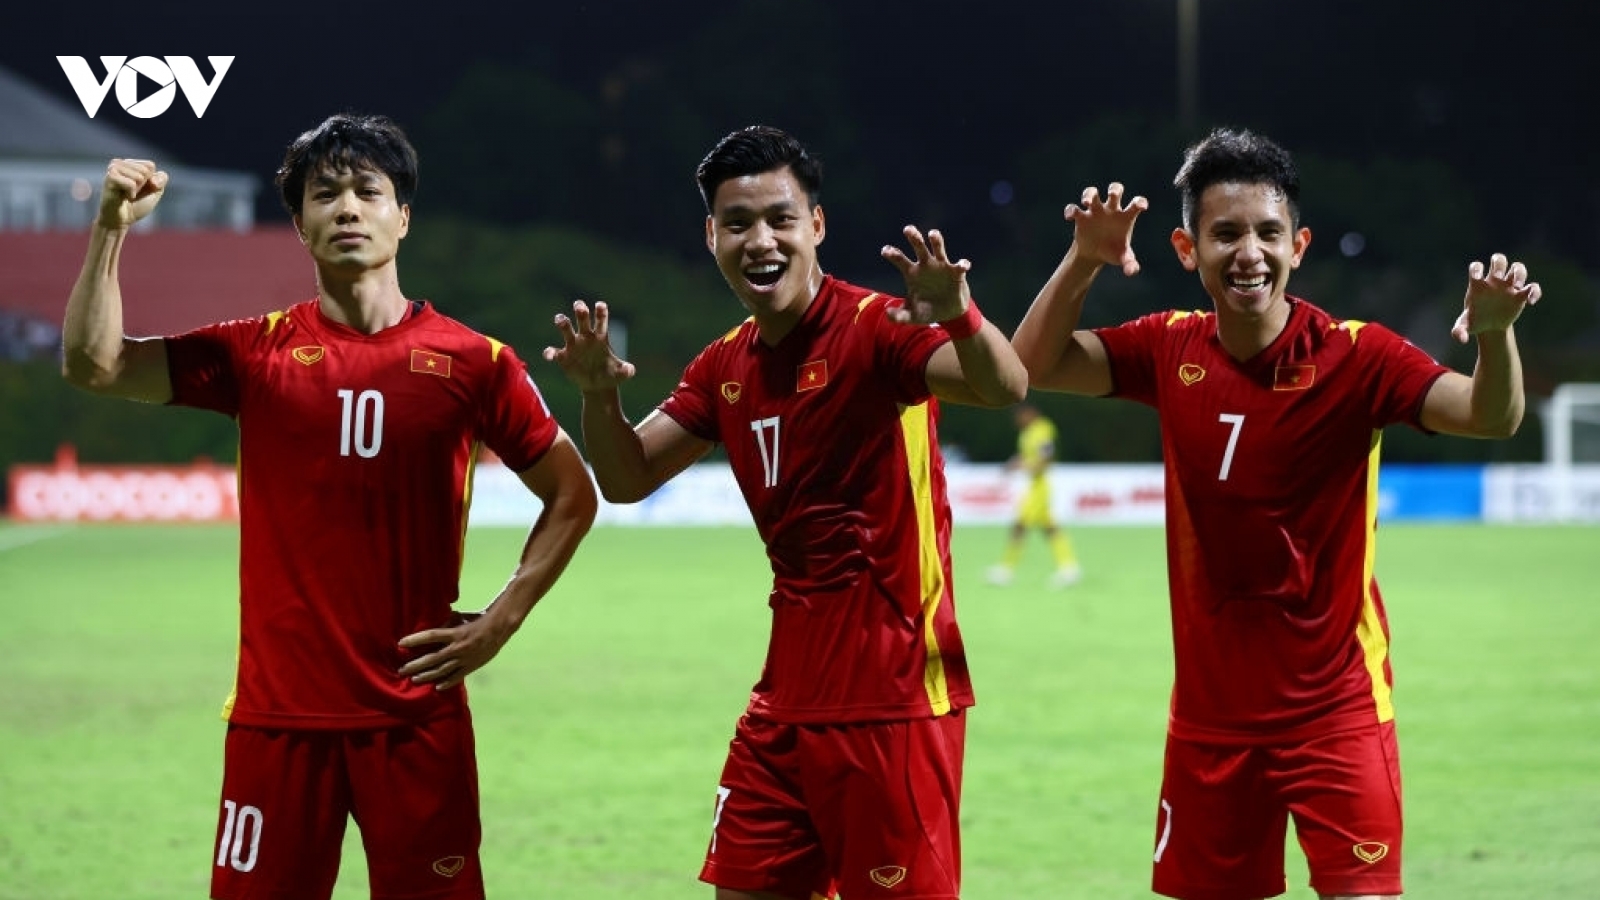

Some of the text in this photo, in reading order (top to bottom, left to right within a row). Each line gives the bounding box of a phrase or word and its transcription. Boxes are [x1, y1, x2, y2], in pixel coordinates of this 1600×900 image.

[337, 389, 384, 458] 10
[750, 416, 780, 488] 17
[1218, 413, 1246, 481] 7
[216, 799, 264, 873] 10
